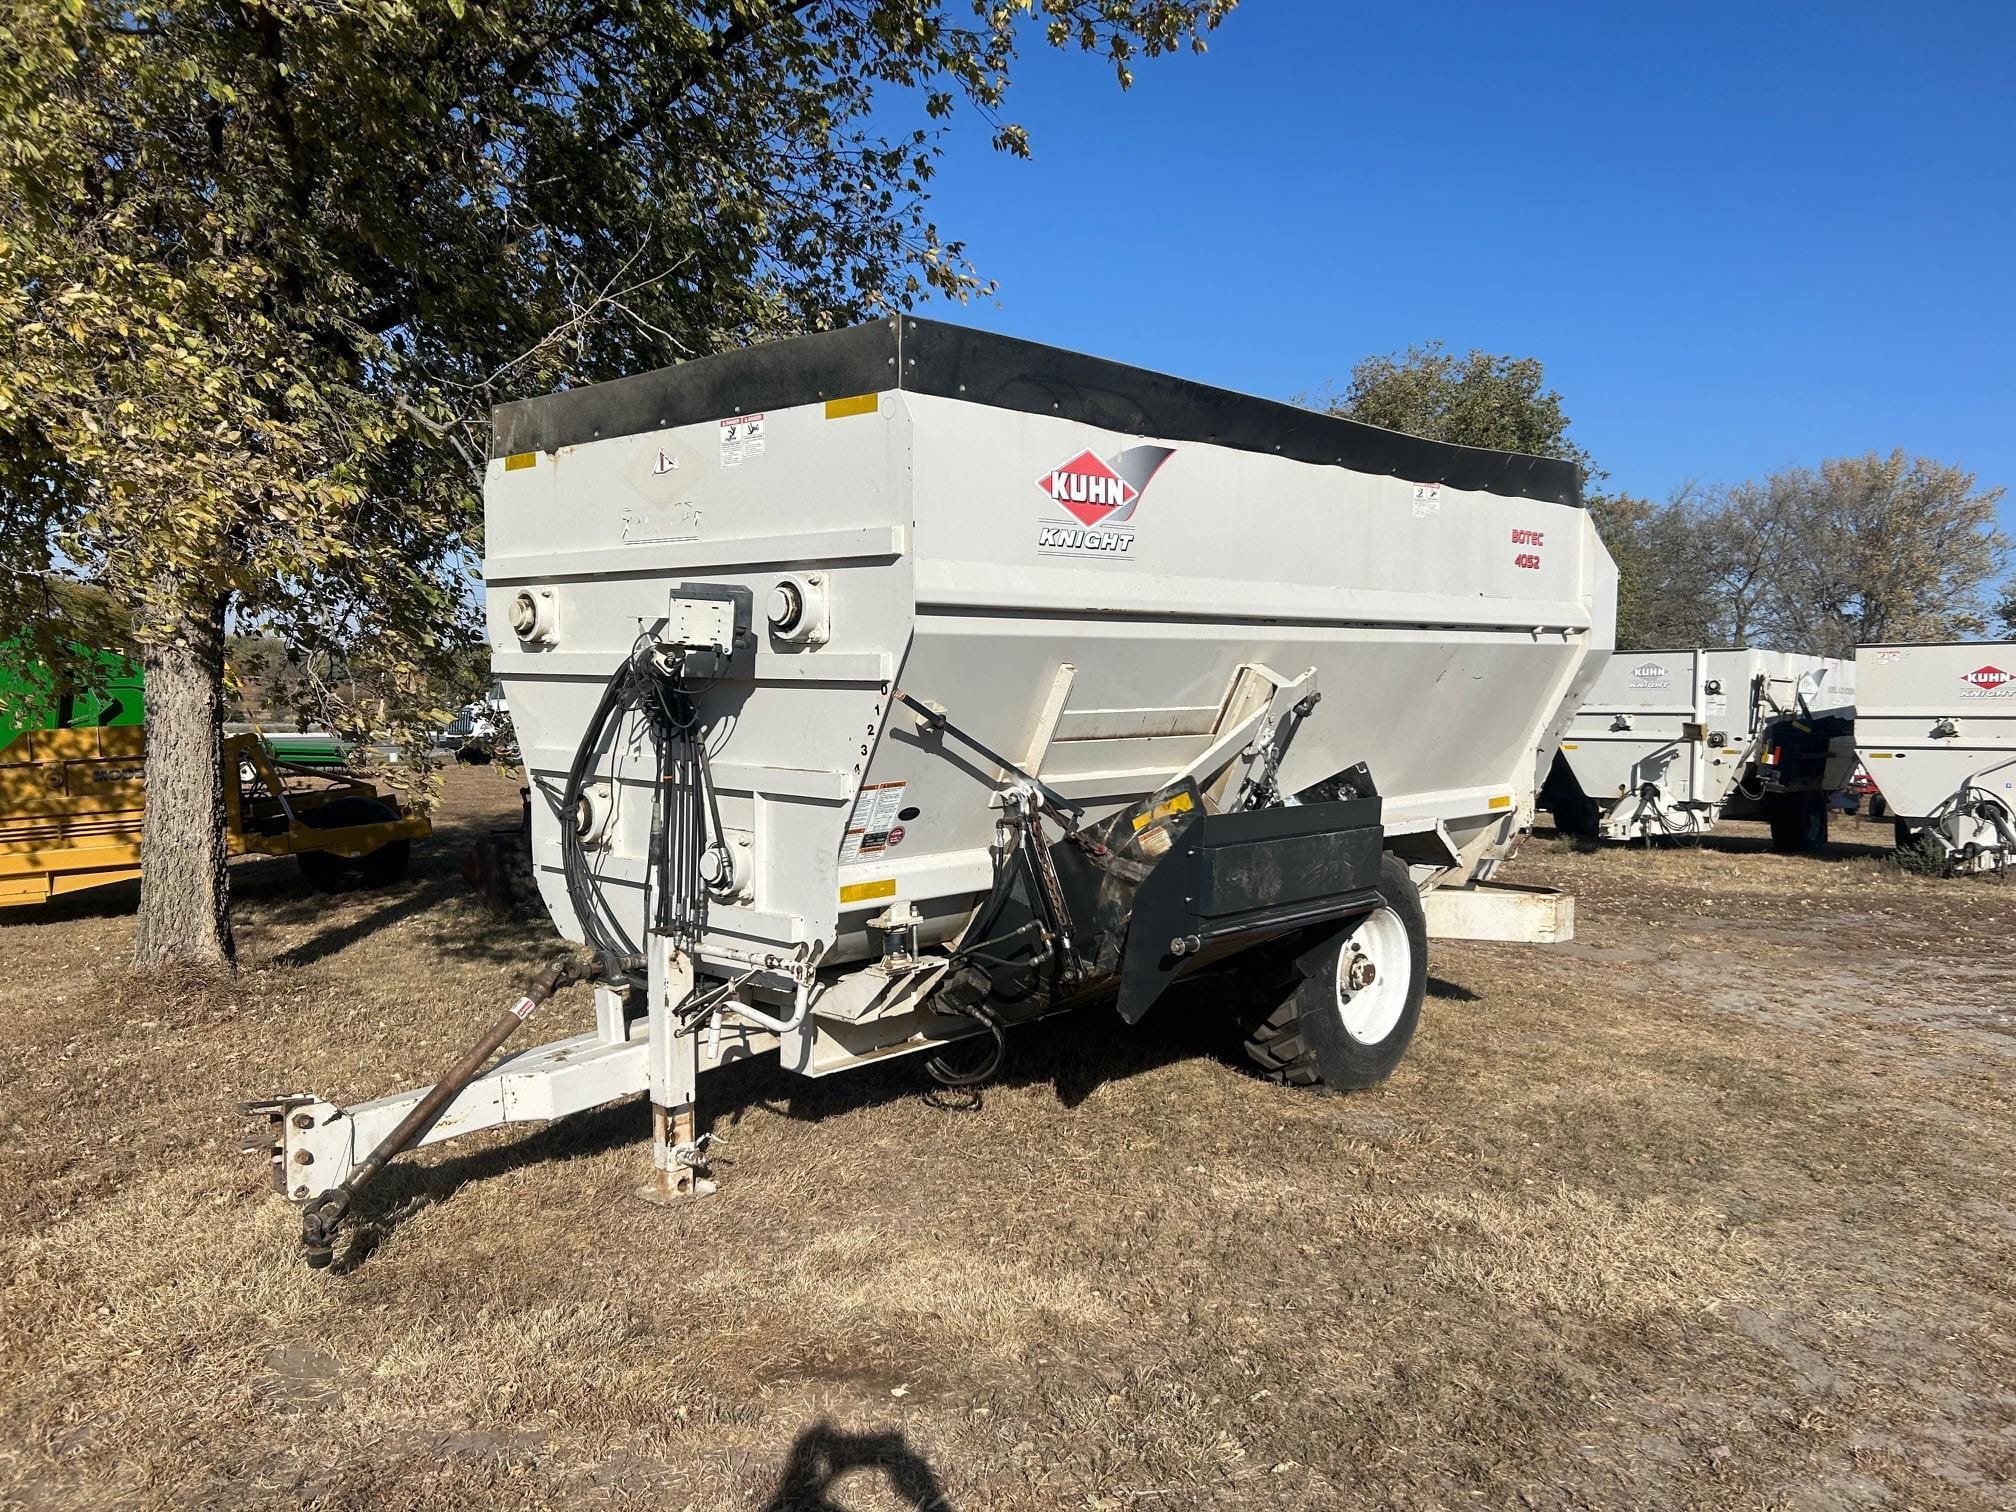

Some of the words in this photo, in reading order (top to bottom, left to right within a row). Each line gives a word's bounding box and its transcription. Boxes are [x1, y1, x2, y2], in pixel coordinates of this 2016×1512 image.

[1051, 471, 1125, 506] KUHN
[1038, 528, 1134, 551] KNIGHT
[1512, 529, 1544, 546] BOTEC
[1514, 554, 1540, 569] 4052
[1634, 668, 1665, 677] KUHN
[1968, 673, 2010, 682] KUHN
[881, 684, 888, 695] 0
[874, 704, 880, 715] 1
[867, 724, 874, 735] 2
[860, 744, 867, 755] 3
